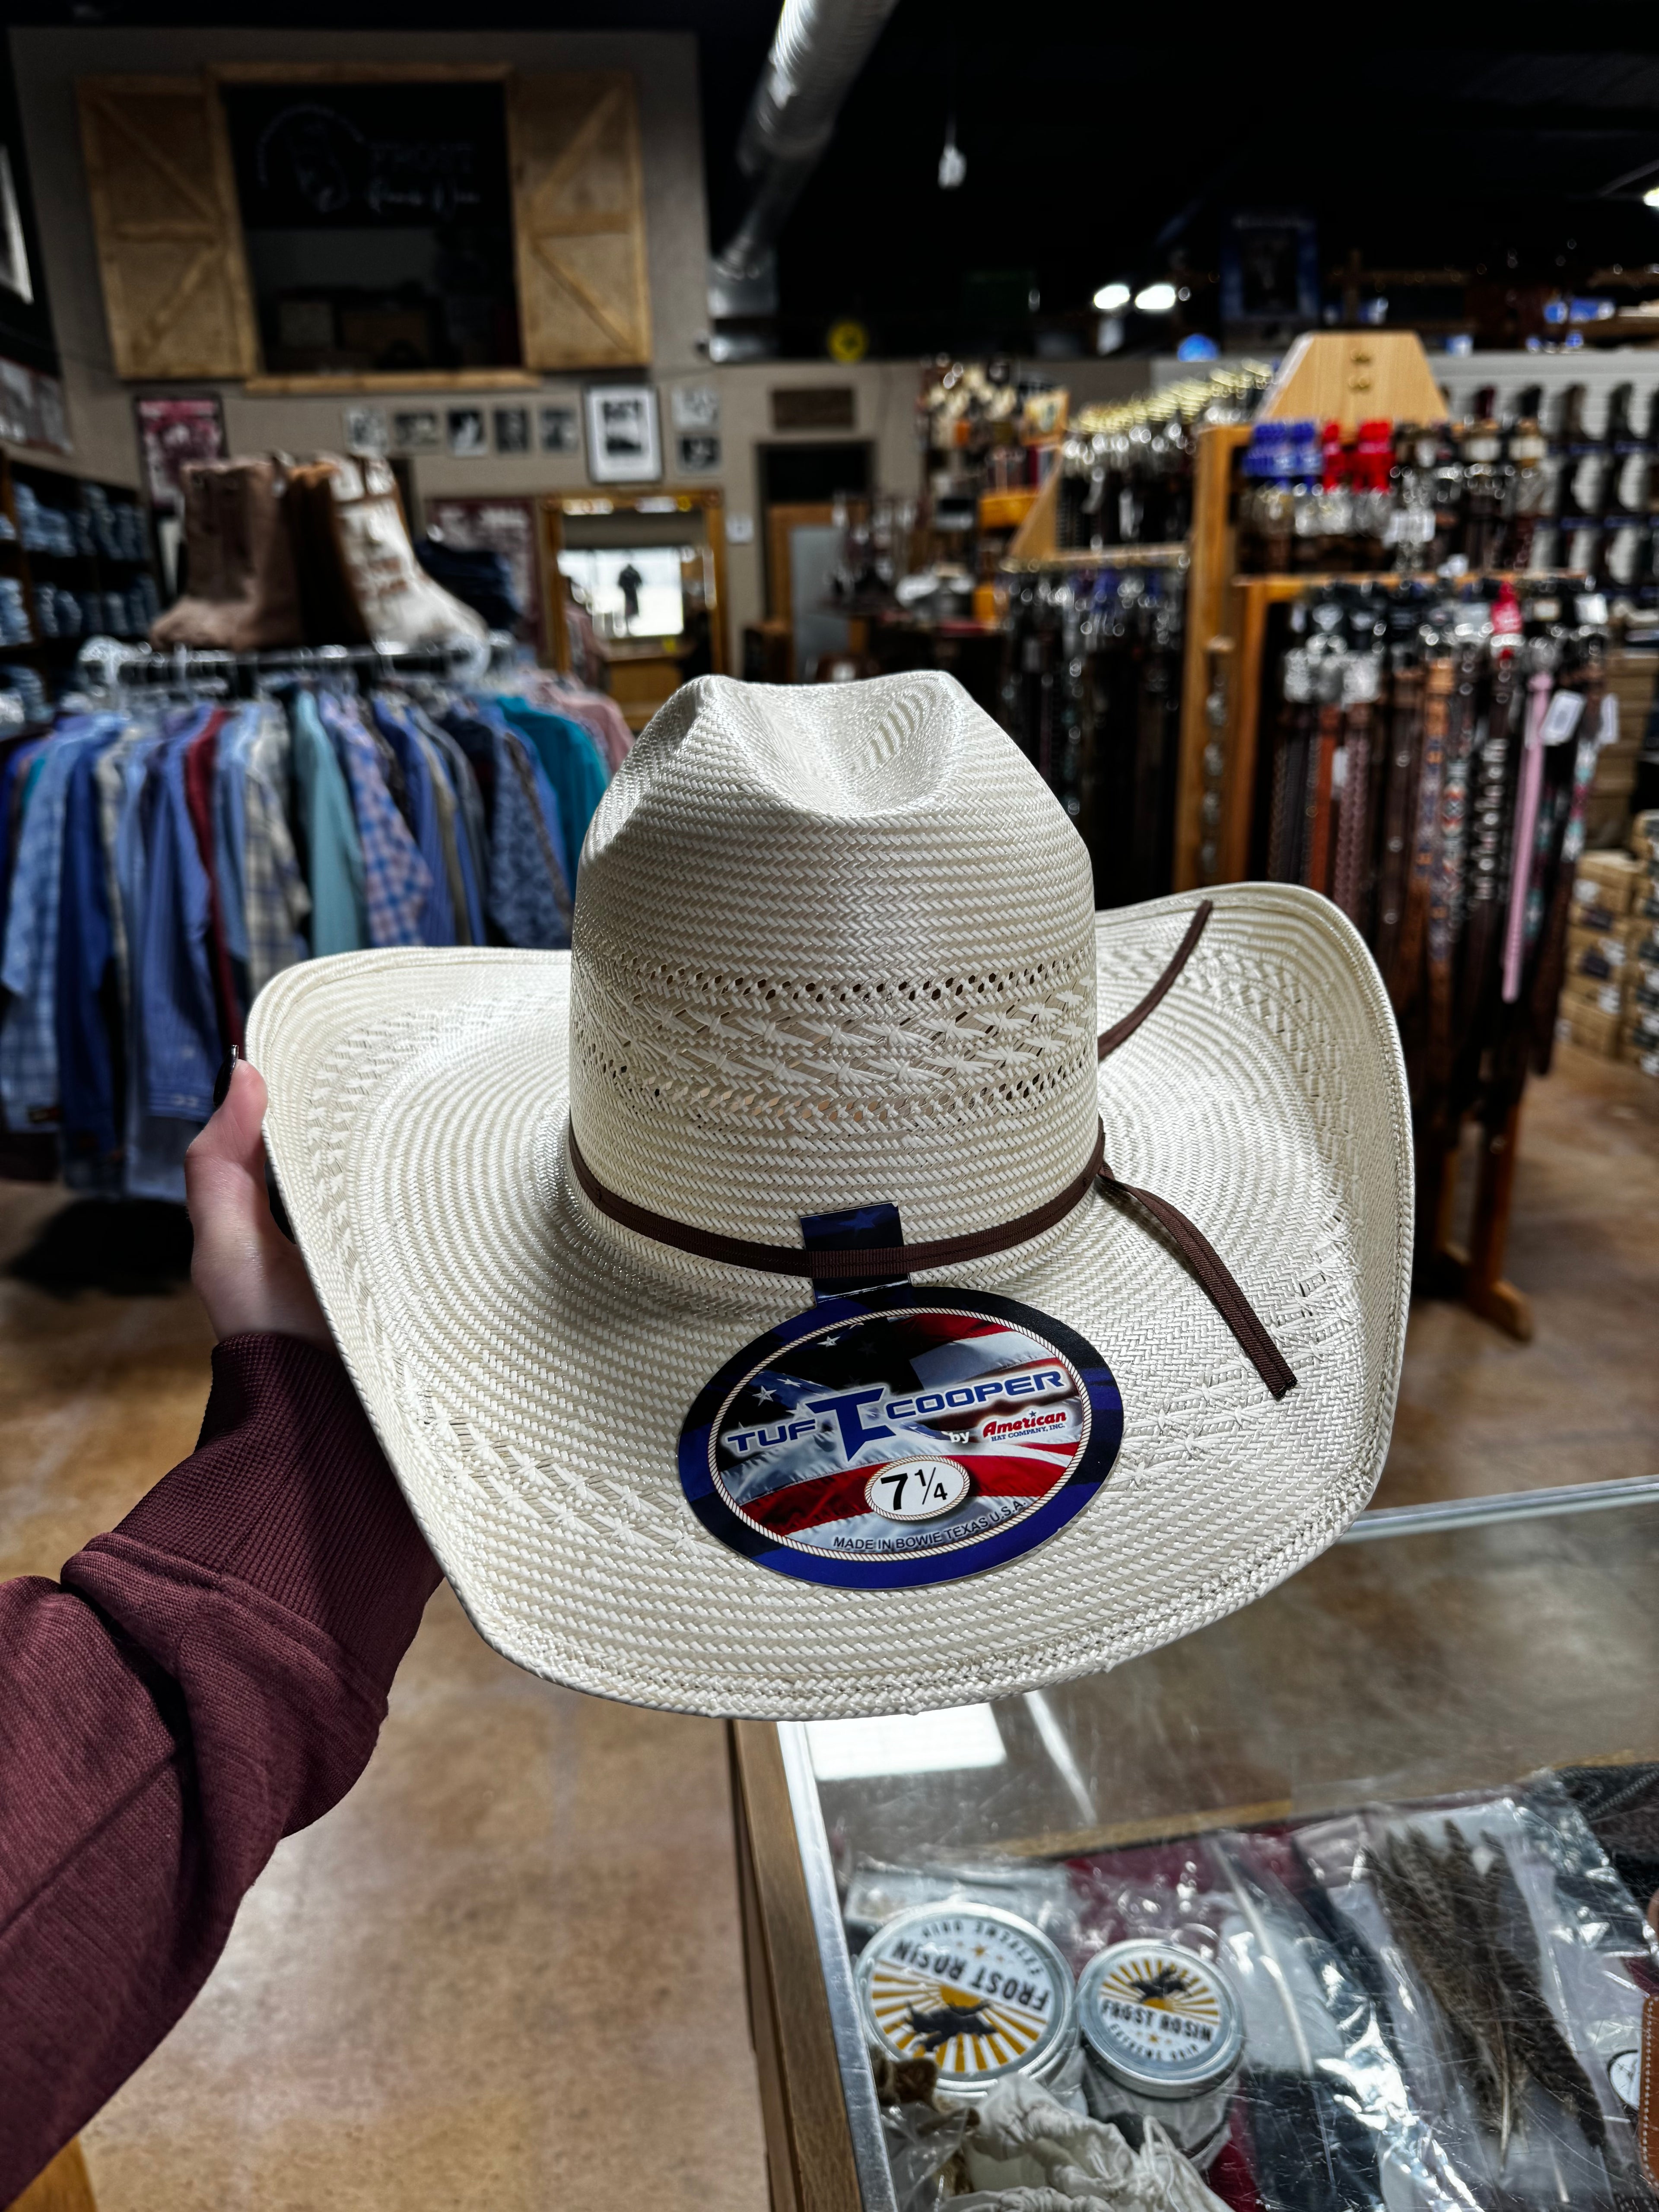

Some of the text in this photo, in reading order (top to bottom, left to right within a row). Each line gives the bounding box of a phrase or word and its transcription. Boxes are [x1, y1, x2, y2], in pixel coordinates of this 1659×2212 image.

[728, 1419, 816, 1452] TUF
[886, 1370, 1065, 1420] COOPER
[950, 1411, 1067, 1444] by American
[1008, 1427, 1048, 1439] COMPANY,
[880, 1472, 908, 1511] 7
[833, 1500, 1027, 1550] MADE IN BOWIE TEXAS U.S.A.
[892, 1939, 1050, 2011] FROST ROSIN
[1102, 1998, 1213, 2042] FROST ROSIN
